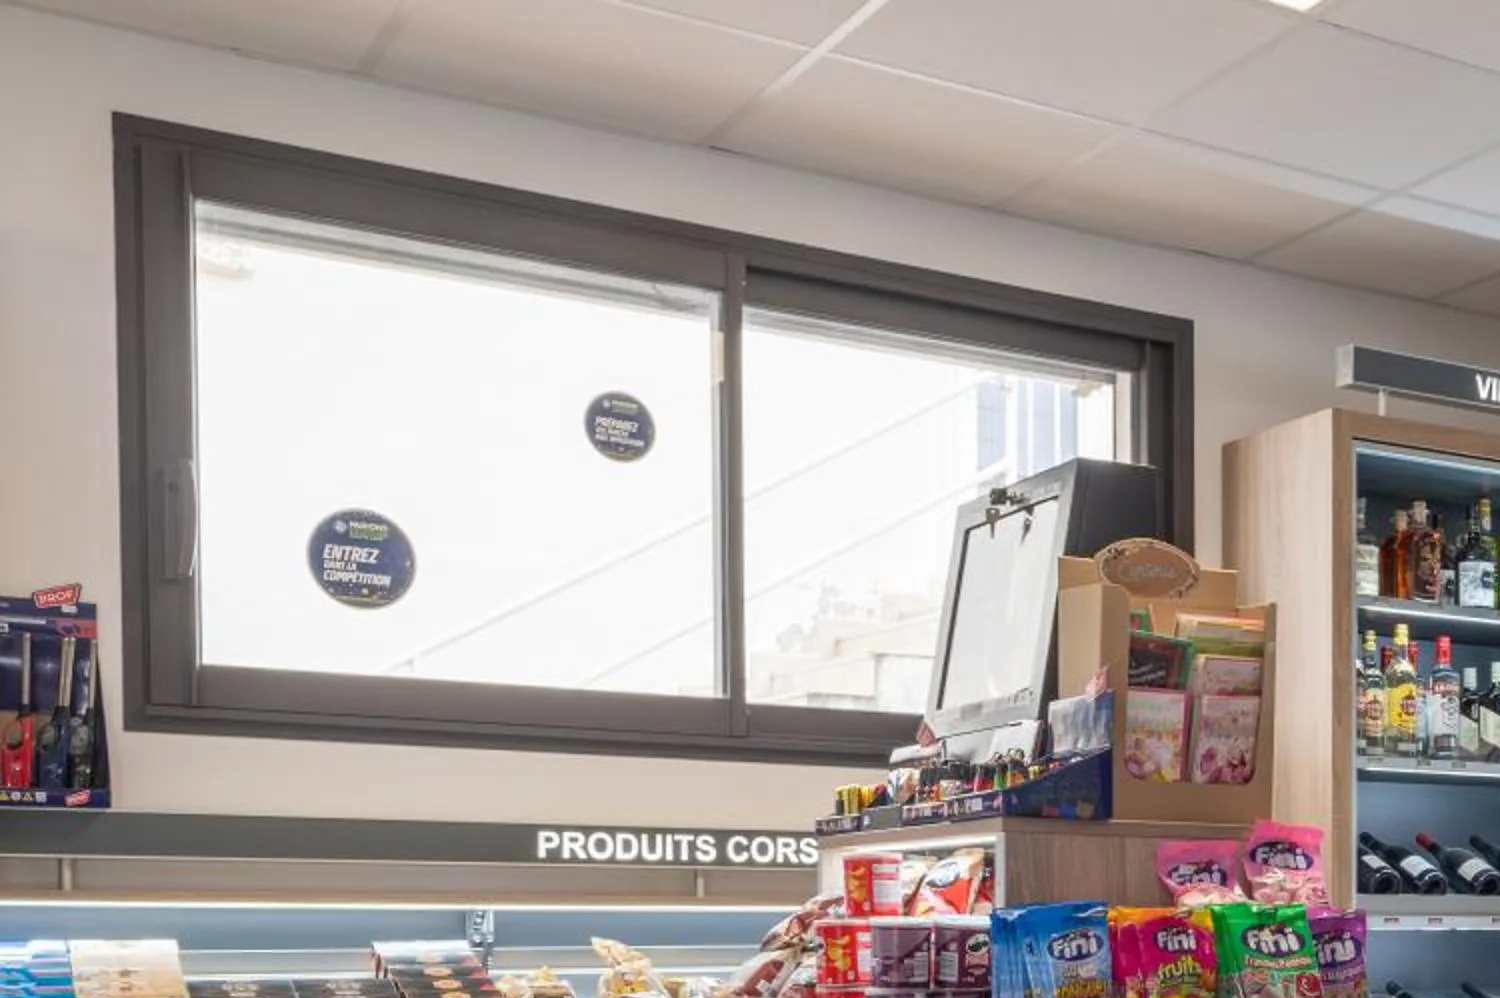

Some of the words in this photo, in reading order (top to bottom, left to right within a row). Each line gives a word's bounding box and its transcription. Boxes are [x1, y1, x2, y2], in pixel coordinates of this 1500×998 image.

[323, 543, 380, 564] ENTREZ
[537, 831, 716, 862] PRODUITS
[726, 835, 819, 863] CORS
